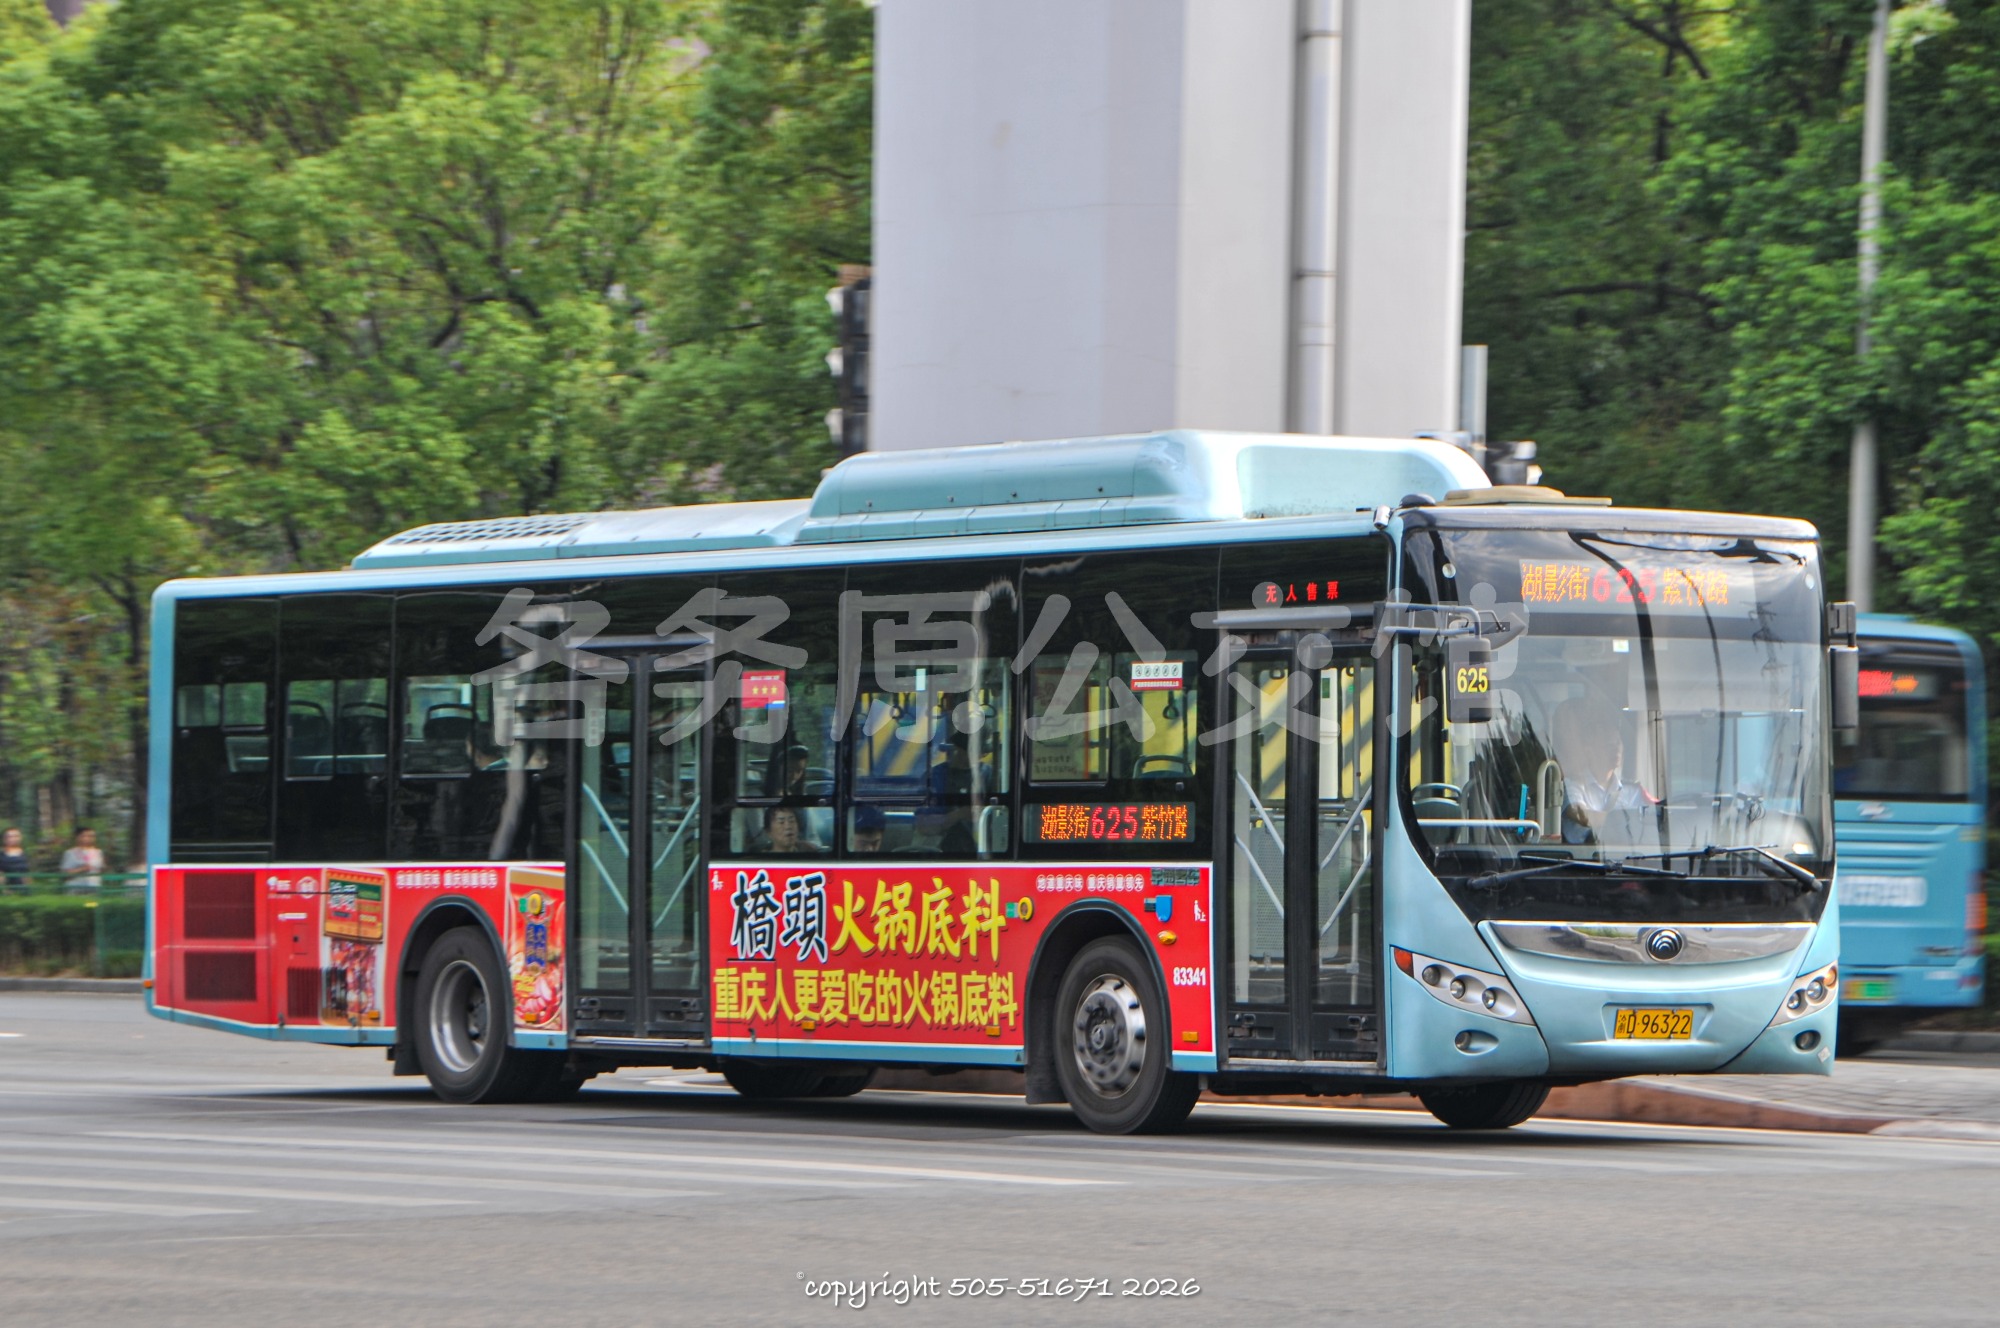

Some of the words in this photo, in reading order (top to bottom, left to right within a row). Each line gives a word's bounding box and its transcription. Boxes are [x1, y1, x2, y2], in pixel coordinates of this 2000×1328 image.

[1265, 581, 1339, 603] 无人售票
[1592, 567, 1657, 604] 625
[1456, 667, 1489, 694] 625
[1091, 805, 1138, 840] 625
[831, 876, 1007, 962] 火锅底料
[1173, 966, 1206, 986] 83341
[713, 968, 1018, 1027] 重庆人更爱吃的火锅底料
